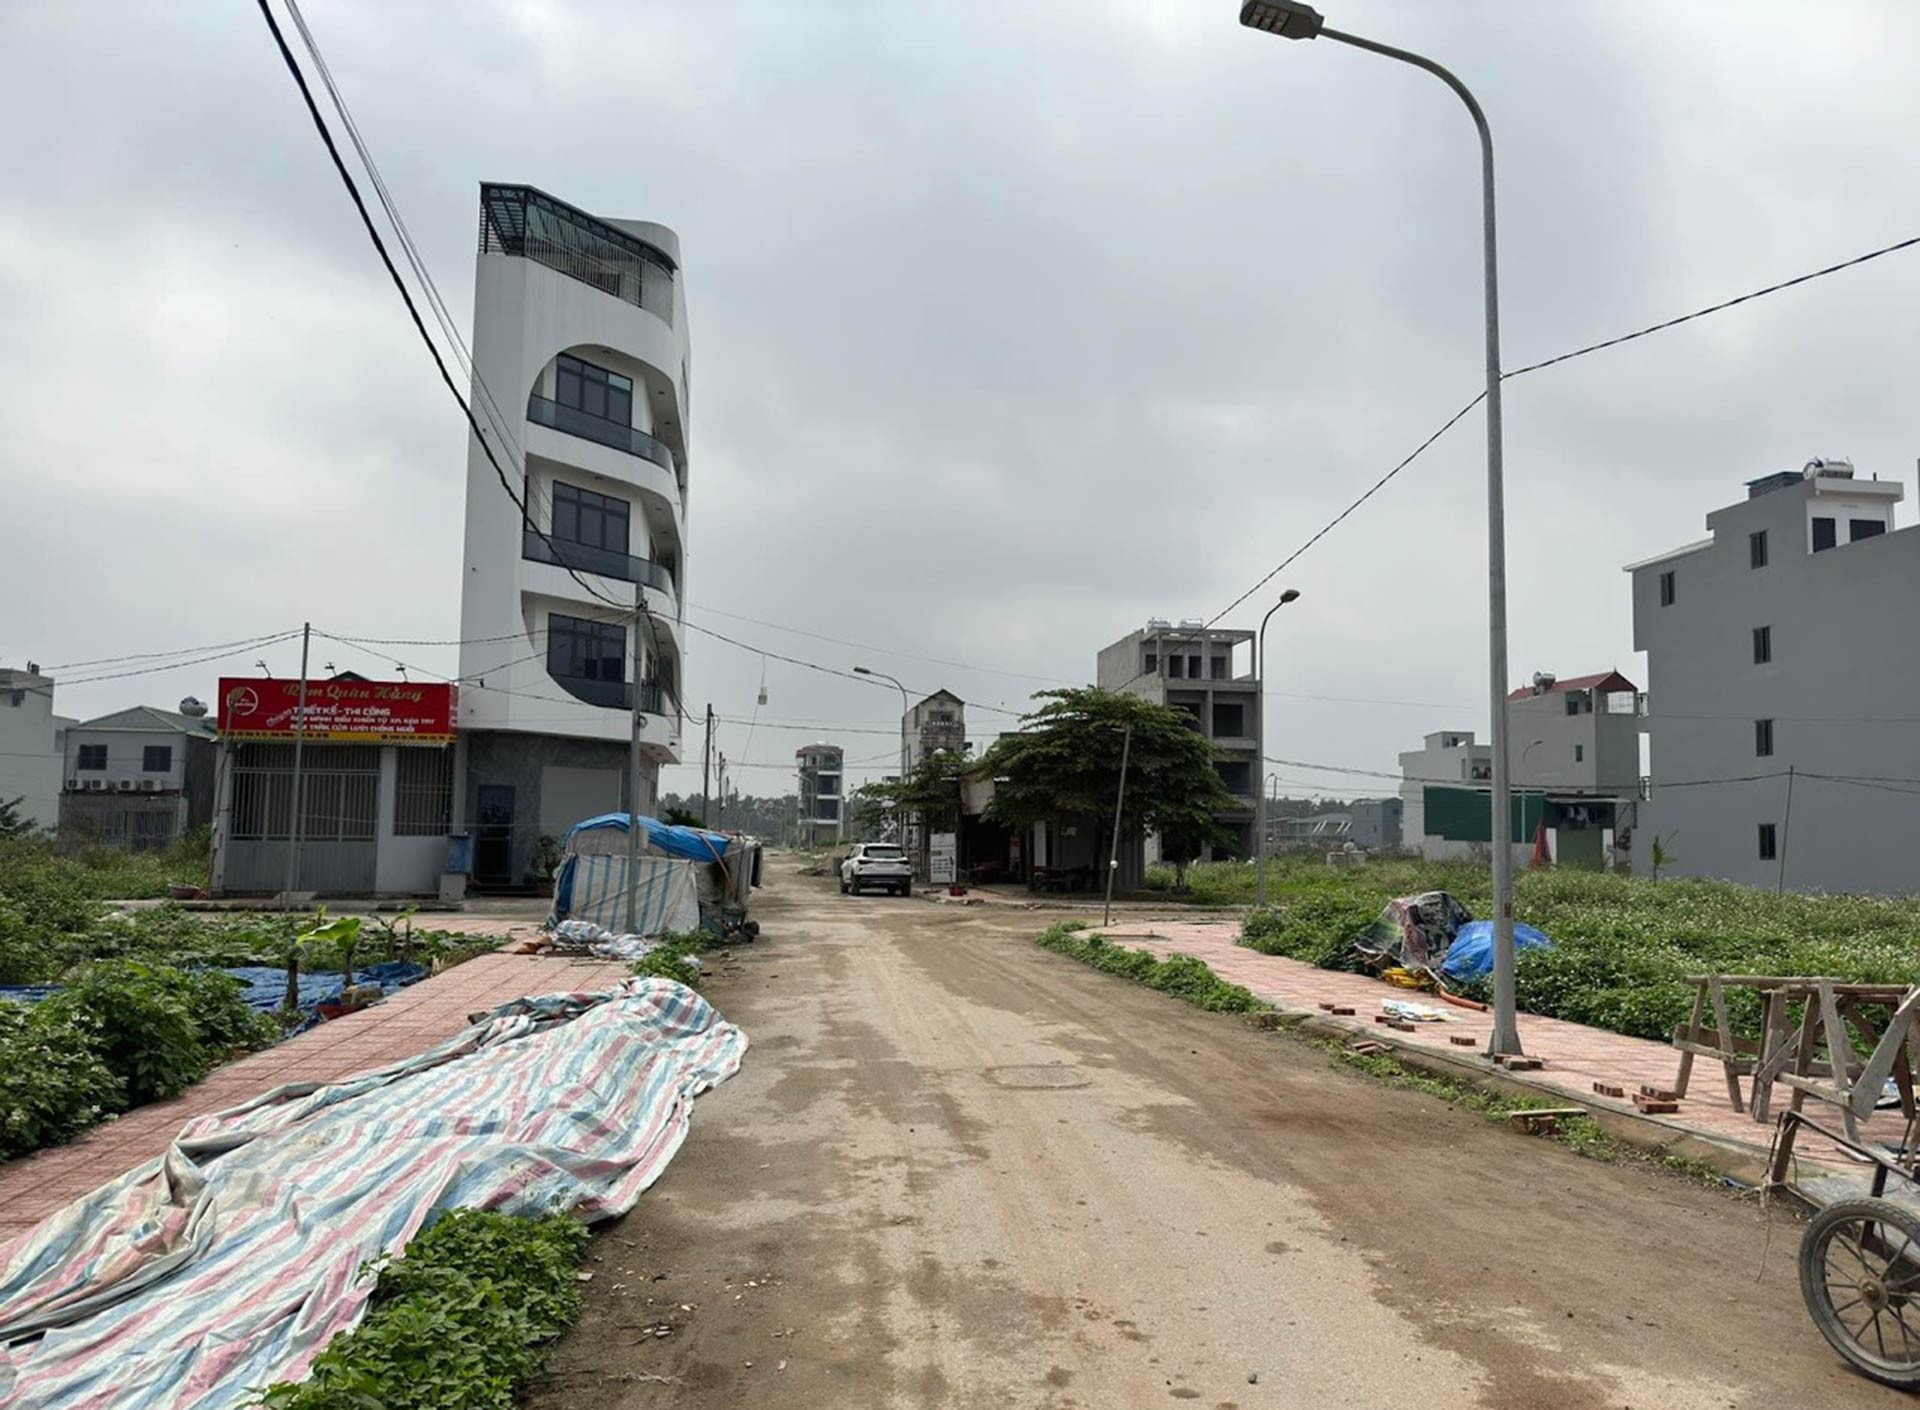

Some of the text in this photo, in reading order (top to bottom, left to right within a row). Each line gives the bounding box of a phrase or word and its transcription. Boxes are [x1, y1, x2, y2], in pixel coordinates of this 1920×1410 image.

[284, 683, 323, 697] Rm
[344, 708, 361, 716] THI
[363, 706, 391, 716] CÔNG
